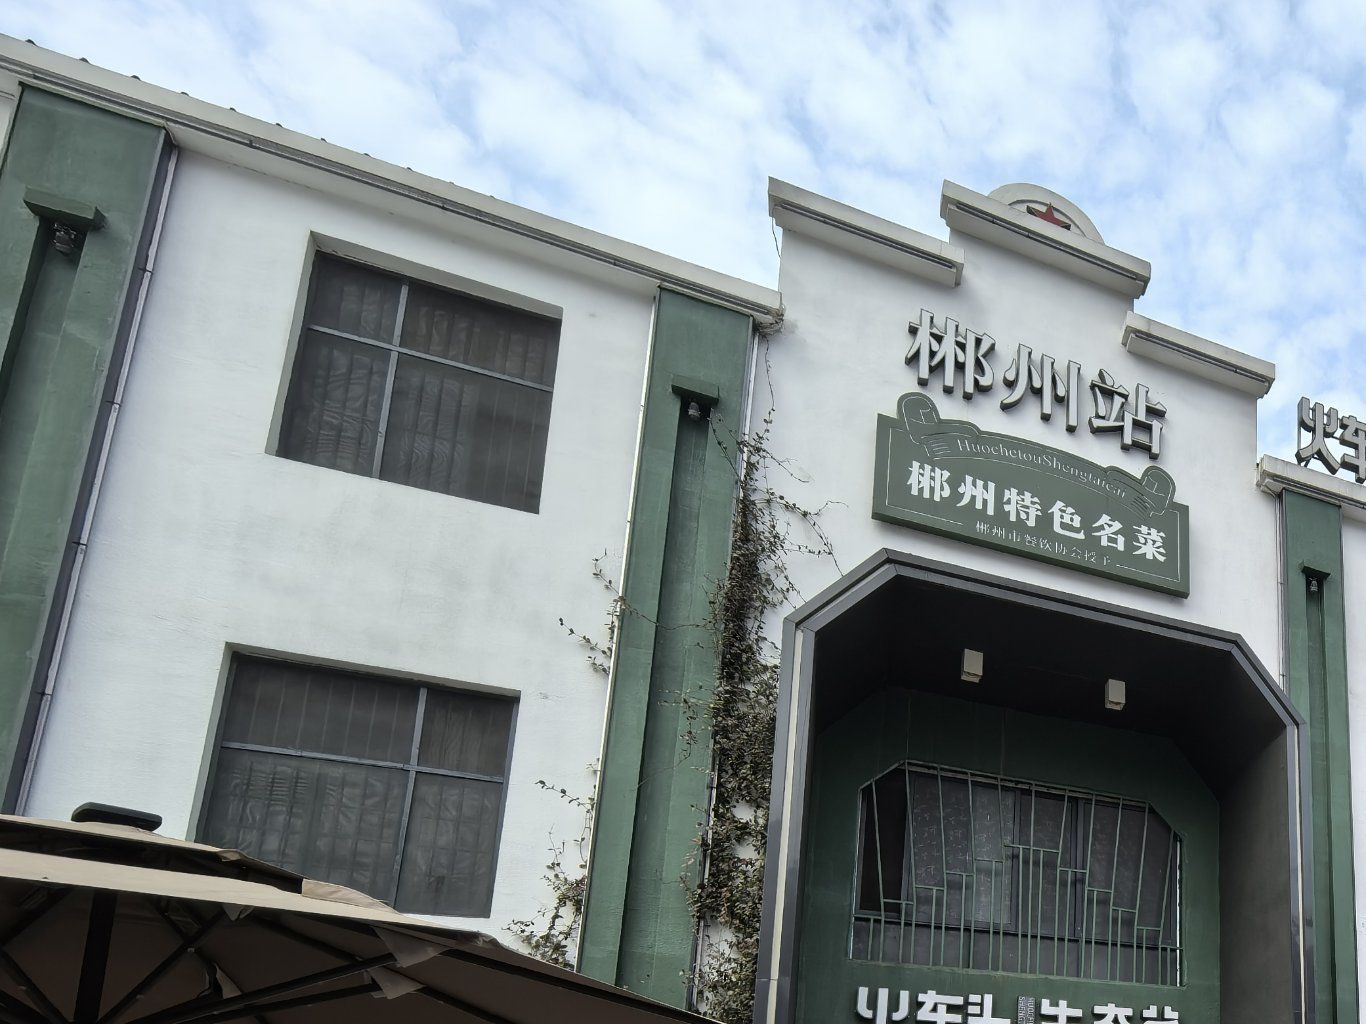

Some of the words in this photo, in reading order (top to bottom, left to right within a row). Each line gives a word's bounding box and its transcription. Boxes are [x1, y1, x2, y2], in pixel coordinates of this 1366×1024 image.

[905, 308, 1167, 459] 郴州站
[907, 460, 1167, 563] 郴州特色名菜
[976, 521, 1111, 566] 郴州市餐饮协会授予
